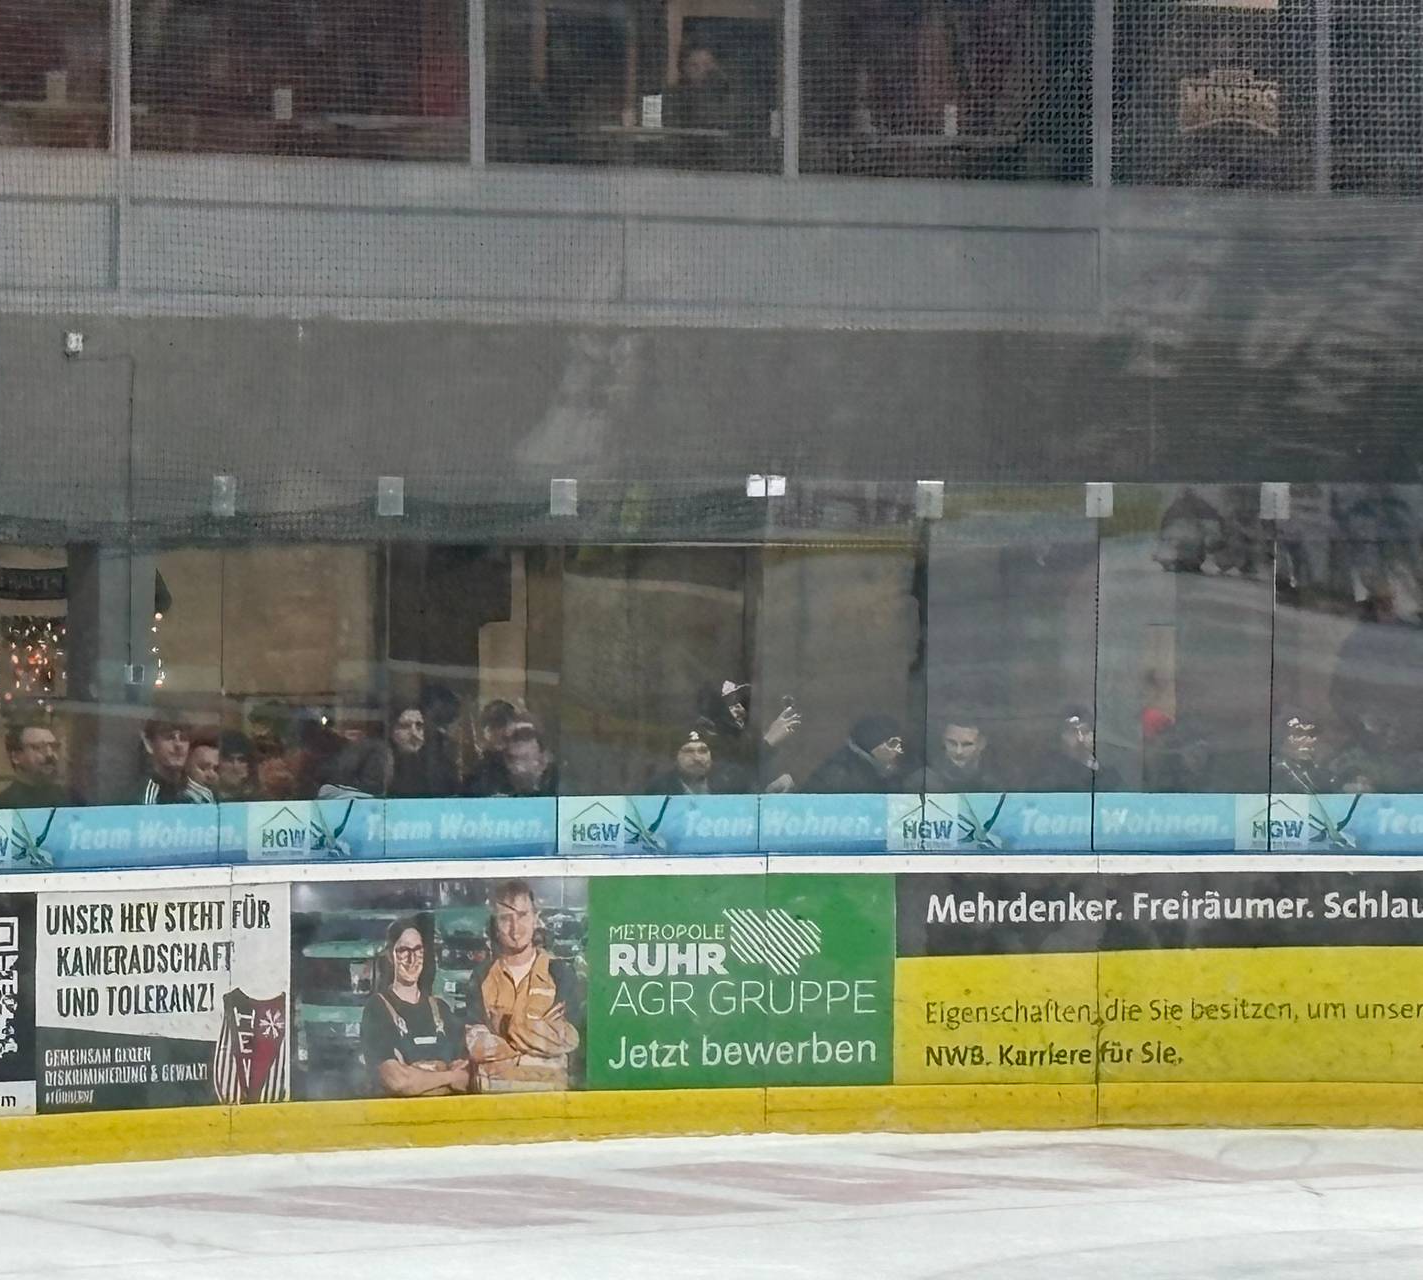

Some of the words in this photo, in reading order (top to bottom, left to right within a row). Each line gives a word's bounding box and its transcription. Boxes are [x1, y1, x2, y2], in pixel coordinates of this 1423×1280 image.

[69, 820, 133, 849] Team
[139, 819, 243, 849] Wohnen.
[571, 822, 620, 841] HGW
[685, 810, 754, 837] Team
[902, 818, 953, 839] HGW
[1252, 818, 1305, 838] HGW
[262, 827, 306, 848] HGW
[46, 902, 113, 936] UNSER
[120, 901, 158, 933] HEV
[164, 900, 225, 932] STEHT
[232, 894, 271, 930] FÜR
[927, 891, 1123, 924] Mehrdenker.
[1133, 889, 1315, 921] Freiräumer.
[609, 924, 725, 940] METROPOLE
[56, 941, 235, 978] KAMERADSCHAFT
[609, 943, 728, 976] RUHR
[56, 987, 99, 1018] UND
[106, 982, 215, 1015] TOLERANZ!
[609, 981, 698, 1016] AGR
[709, 980, 877, 1016] GRUPPE
[1105, 998, 1143, 1022] die
[1150, 998, 1183, 1021] Sie
[1191, 997, 1299, 1024] besitzen,
[1307, 1001, 1346, 1020] um
[45, 1048, 111, 1067] GEMEINSAM
[609, 1035, 689, 1069] Jetzt
[702, 1031, 877, 1067] bewerben
[926, 1046, 993, 1067] NWB.
[999, 1043, 1092, 1067] Karriere
[1099, 1041, 1134, 1065] für
[1142, 1041, 1183, 1064] Sie.
[44, 1065, 147, 1087] DISKRIMINIERUNG
[150, 1064, 159, 1083] &
